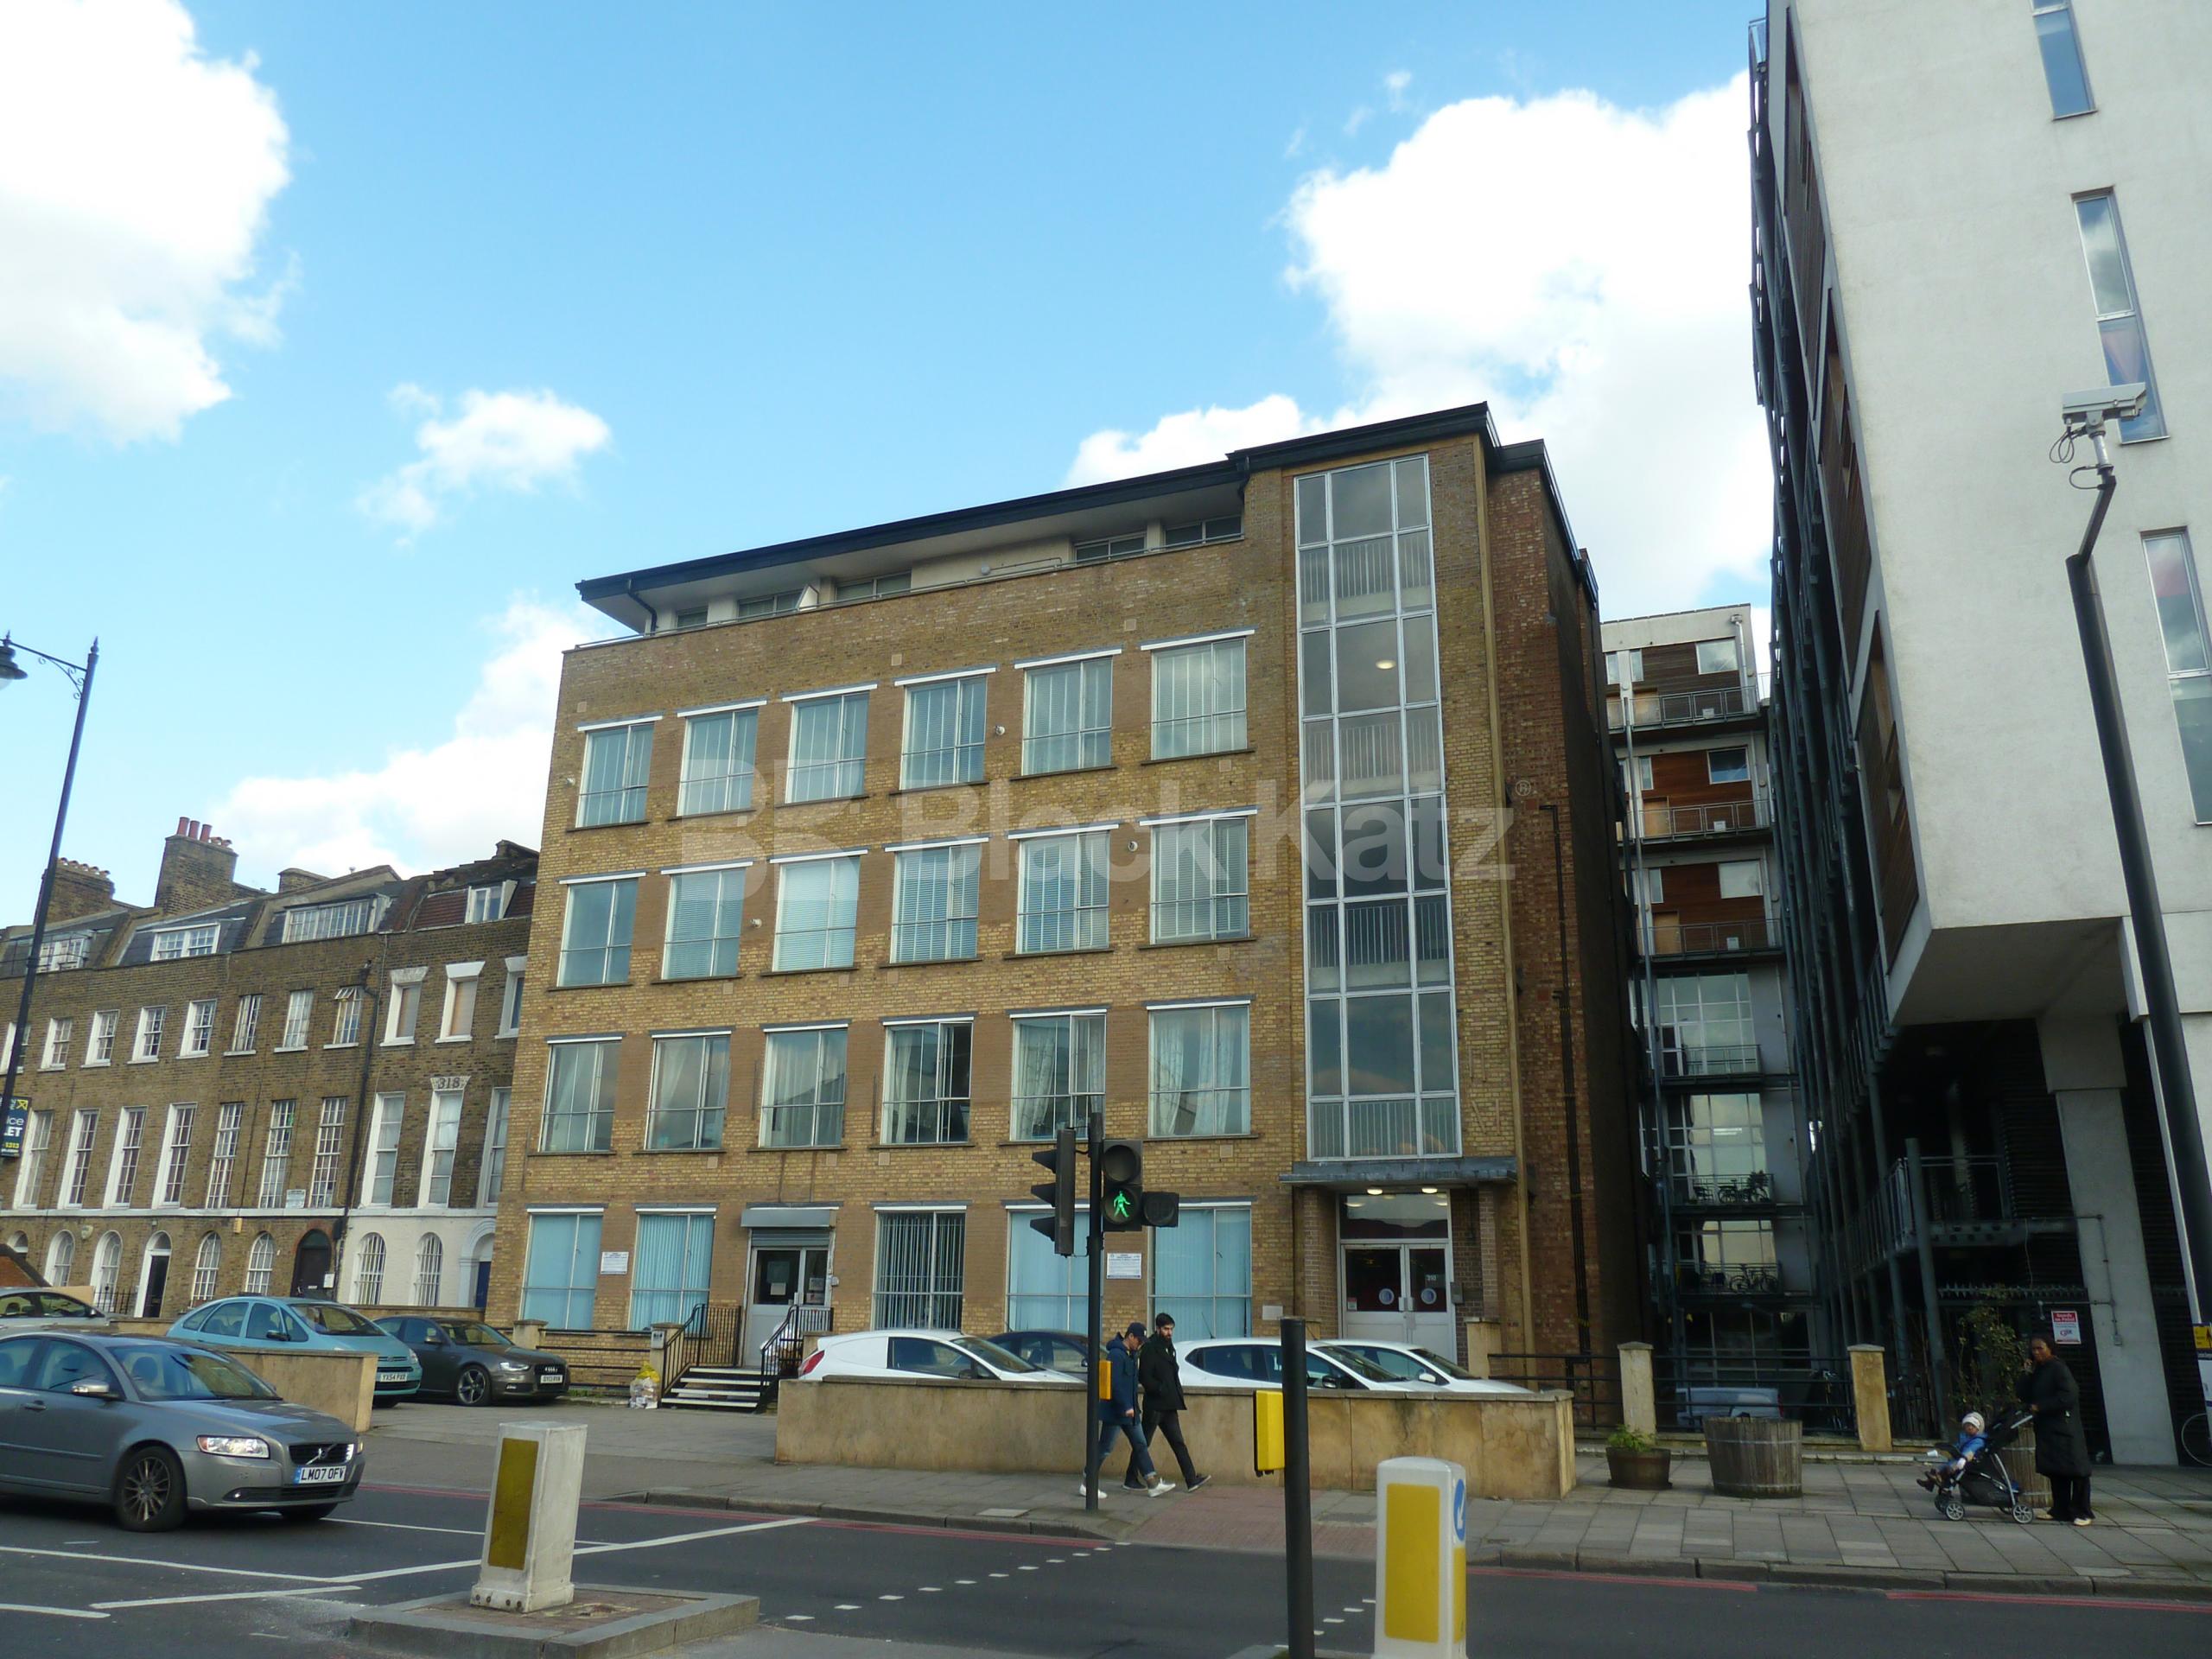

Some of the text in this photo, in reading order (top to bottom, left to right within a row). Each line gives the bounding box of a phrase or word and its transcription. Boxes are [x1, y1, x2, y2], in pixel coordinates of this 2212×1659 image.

[438, 1077, 461, 1089] 318
[301, 1468, 344, 1480] LM07 OFV
